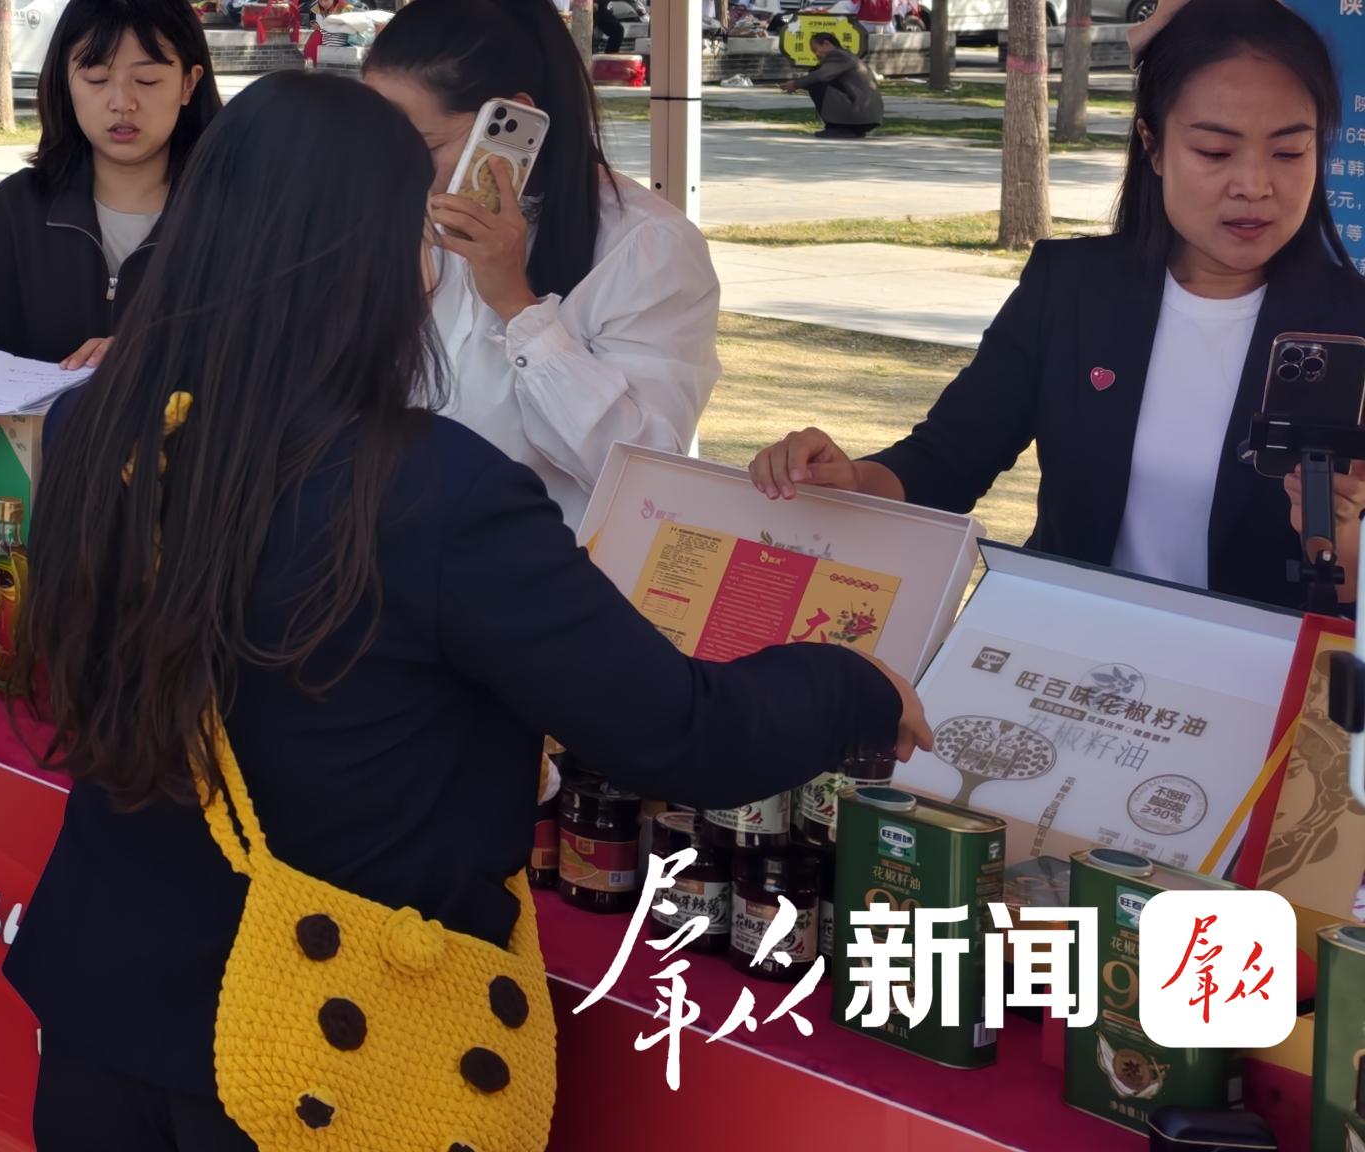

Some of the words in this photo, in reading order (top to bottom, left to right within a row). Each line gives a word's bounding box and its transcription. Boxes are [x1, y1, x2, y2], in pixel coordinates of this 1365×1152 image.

[1324, 158, 1365, 178] 省韩
[1015, 670, 1208, 737] 旺百味花椒籽油
